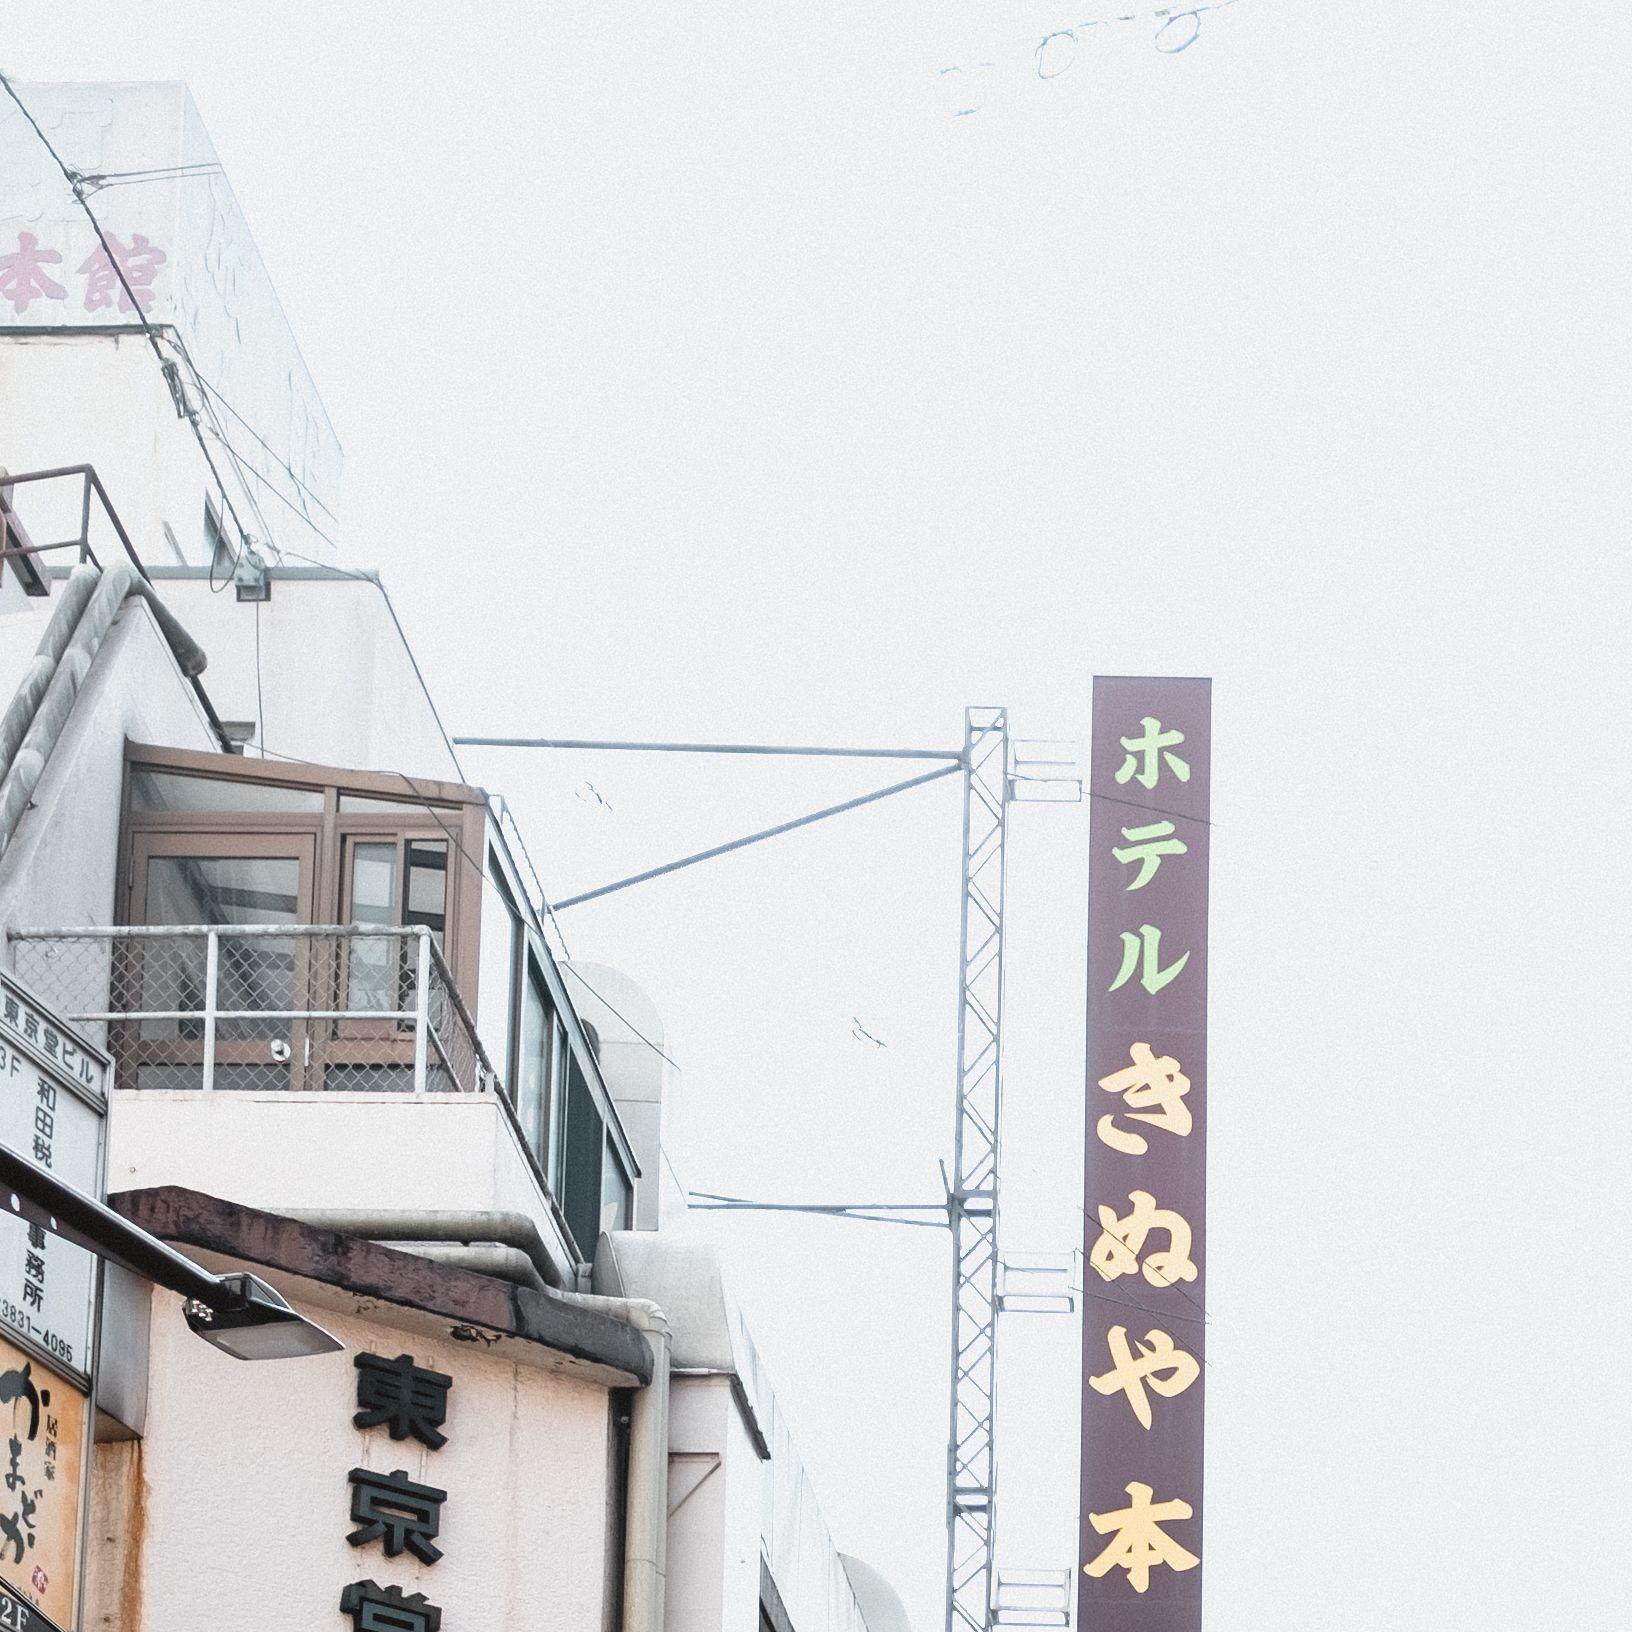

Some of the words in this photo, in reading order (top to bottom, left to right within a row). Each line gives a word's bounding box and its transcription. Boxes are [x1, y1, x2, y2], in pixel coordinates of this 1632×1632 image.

[0, 232, 167, 315] 本館
[3, 994, 95, 1085] 東京堂ビル
[22, 1075, 56, 1313] 和田税事務所
[1, 1597, 29, 1631] 2F
